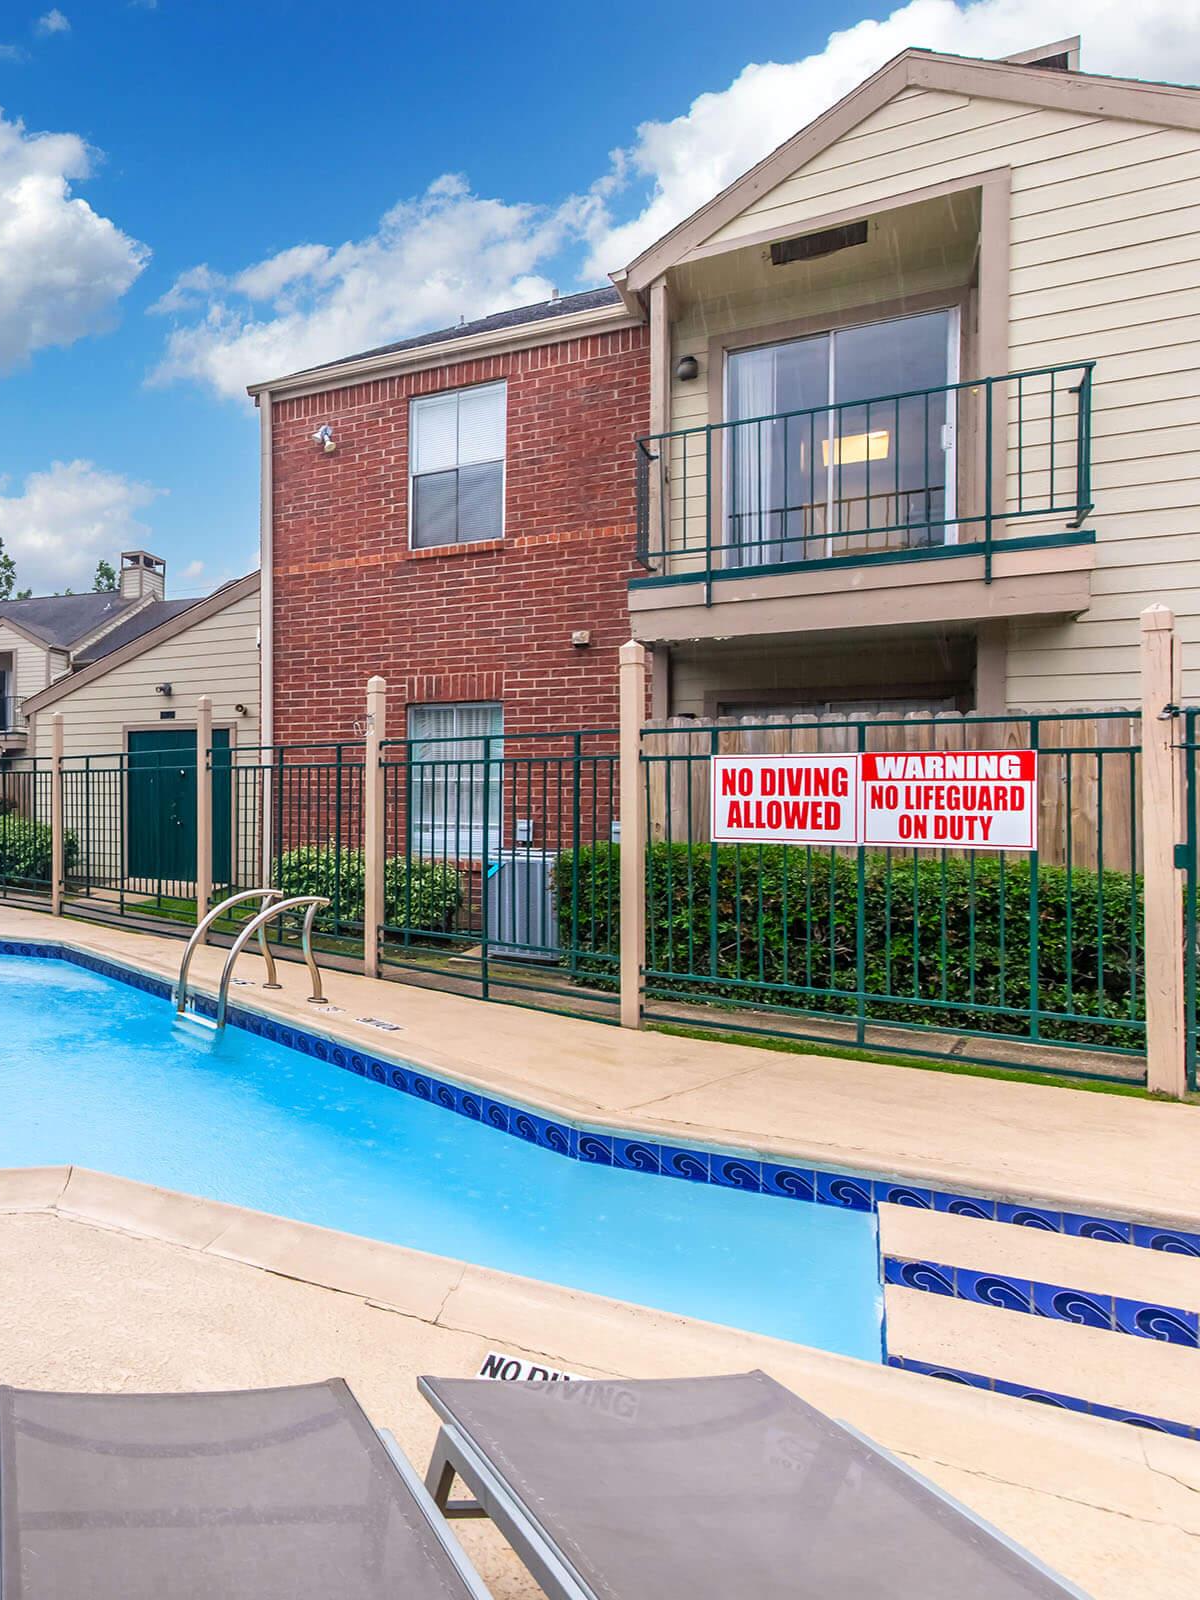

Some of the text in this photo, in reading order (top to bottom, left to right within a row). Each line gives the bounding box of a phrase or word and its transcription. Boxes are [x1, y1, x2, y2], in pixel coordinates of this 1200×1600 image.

[874, 754, 1021, 780] WARNING
[721, 767, 848, 797] NO DIVING
[870, 785, 1025, 811] NO LIFEGUARD
[726, 800, 841, 831] ALLOWED
[898, 815, 993, 840] ON DUTY
[480, 1354, 521, 1381] NO
